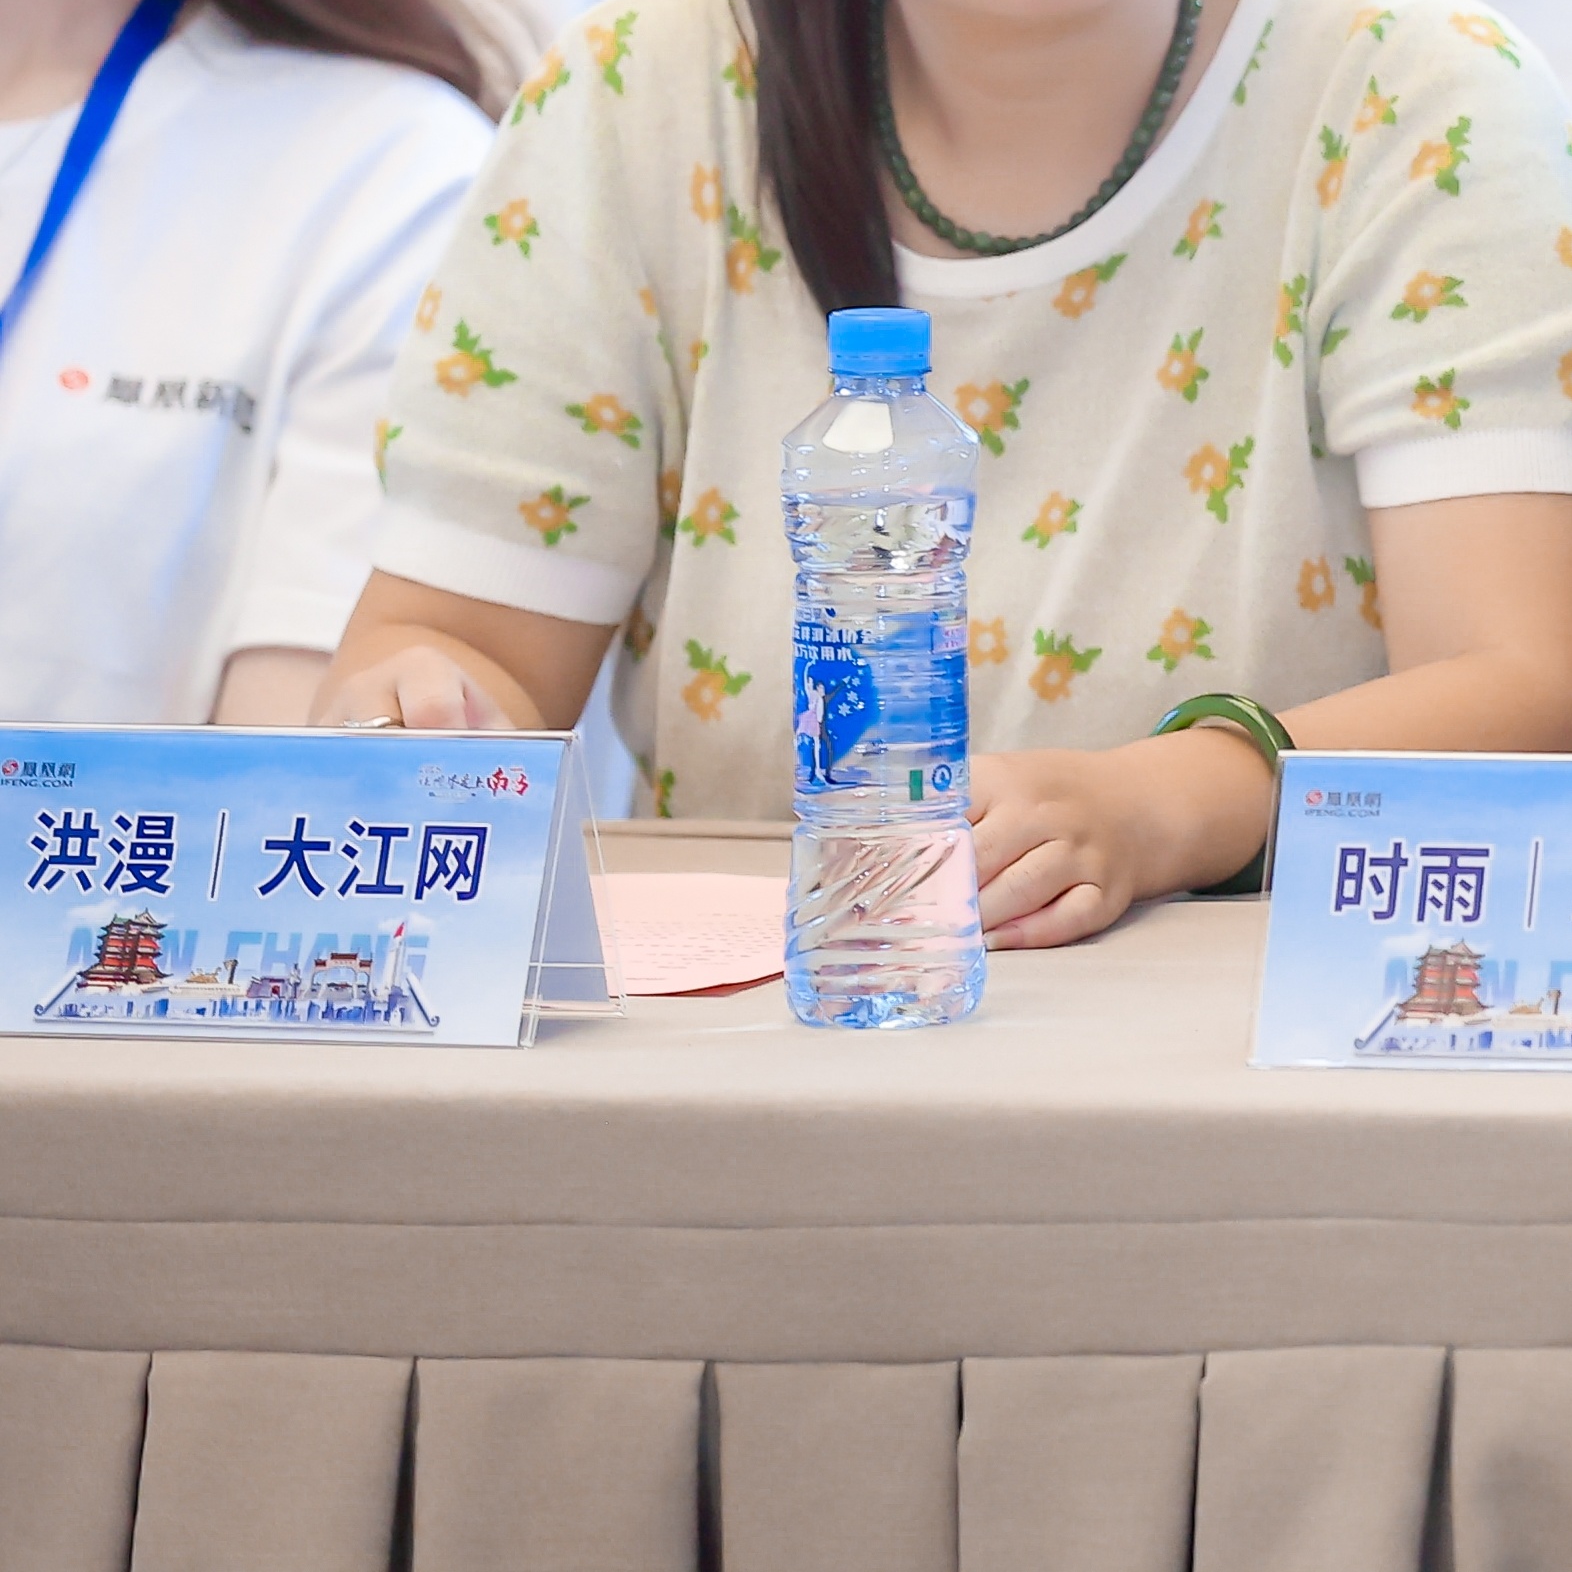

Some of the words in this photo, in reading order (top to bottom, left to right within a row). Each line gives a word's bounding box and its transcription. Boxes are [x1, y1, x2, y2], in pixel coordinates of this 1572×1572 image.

[27, 810, 173, 894] 洪漫
[258, 817, 489, 901] 大江网
[1333, 842, 1490, 923] 时雨
